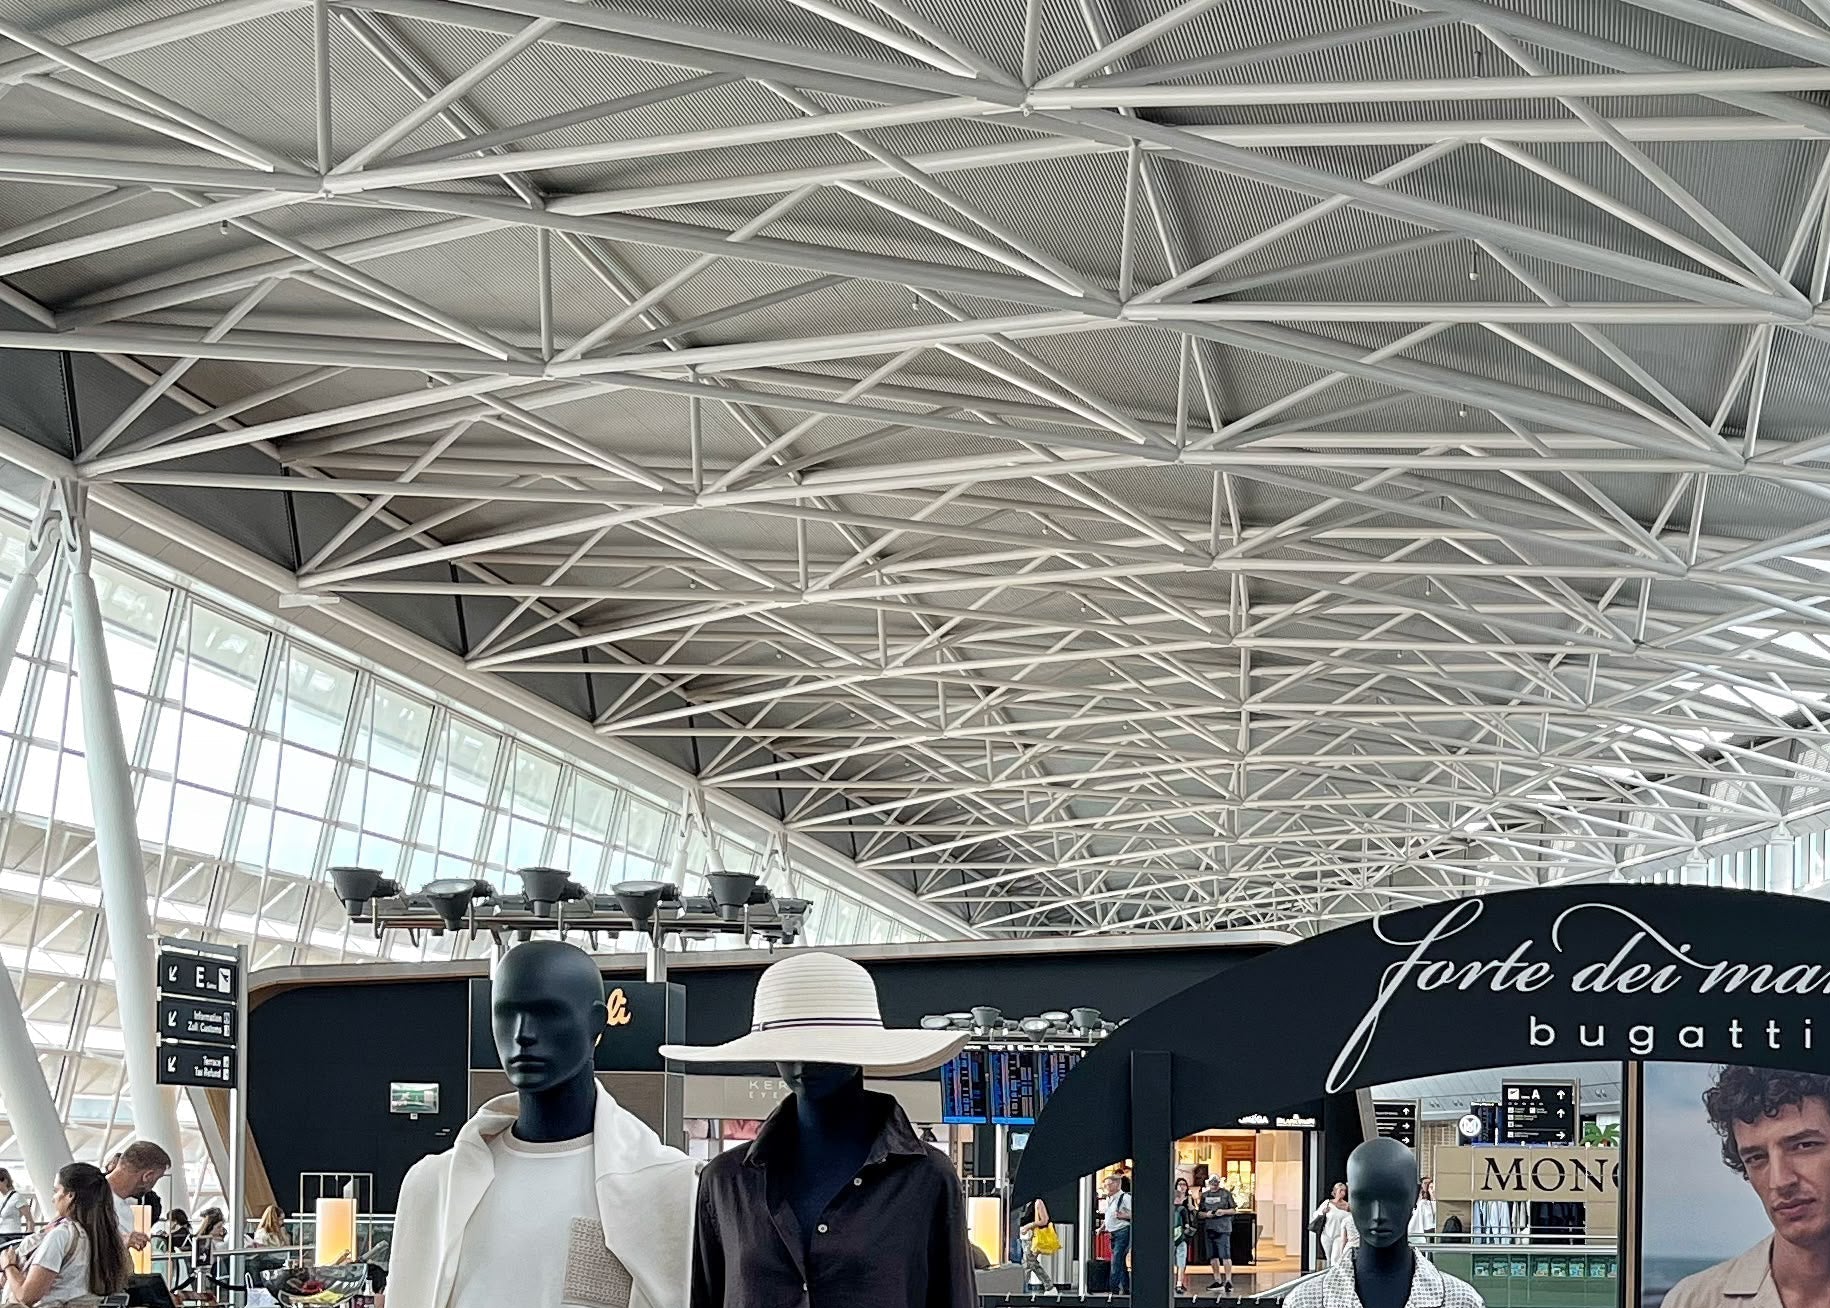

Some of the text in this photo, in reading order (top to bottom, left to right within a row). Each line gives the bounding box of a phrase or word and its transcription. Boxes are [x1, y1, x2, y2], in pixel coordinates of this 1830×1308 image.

[195, 966, 205, 988] E
[1326, 899, 1554, 1094] forte
[1552, 903, 1706, 994] dei
[1529, 1016, 1814, 1054] bugatti
[1531, 1088, 1541, 1100] A
